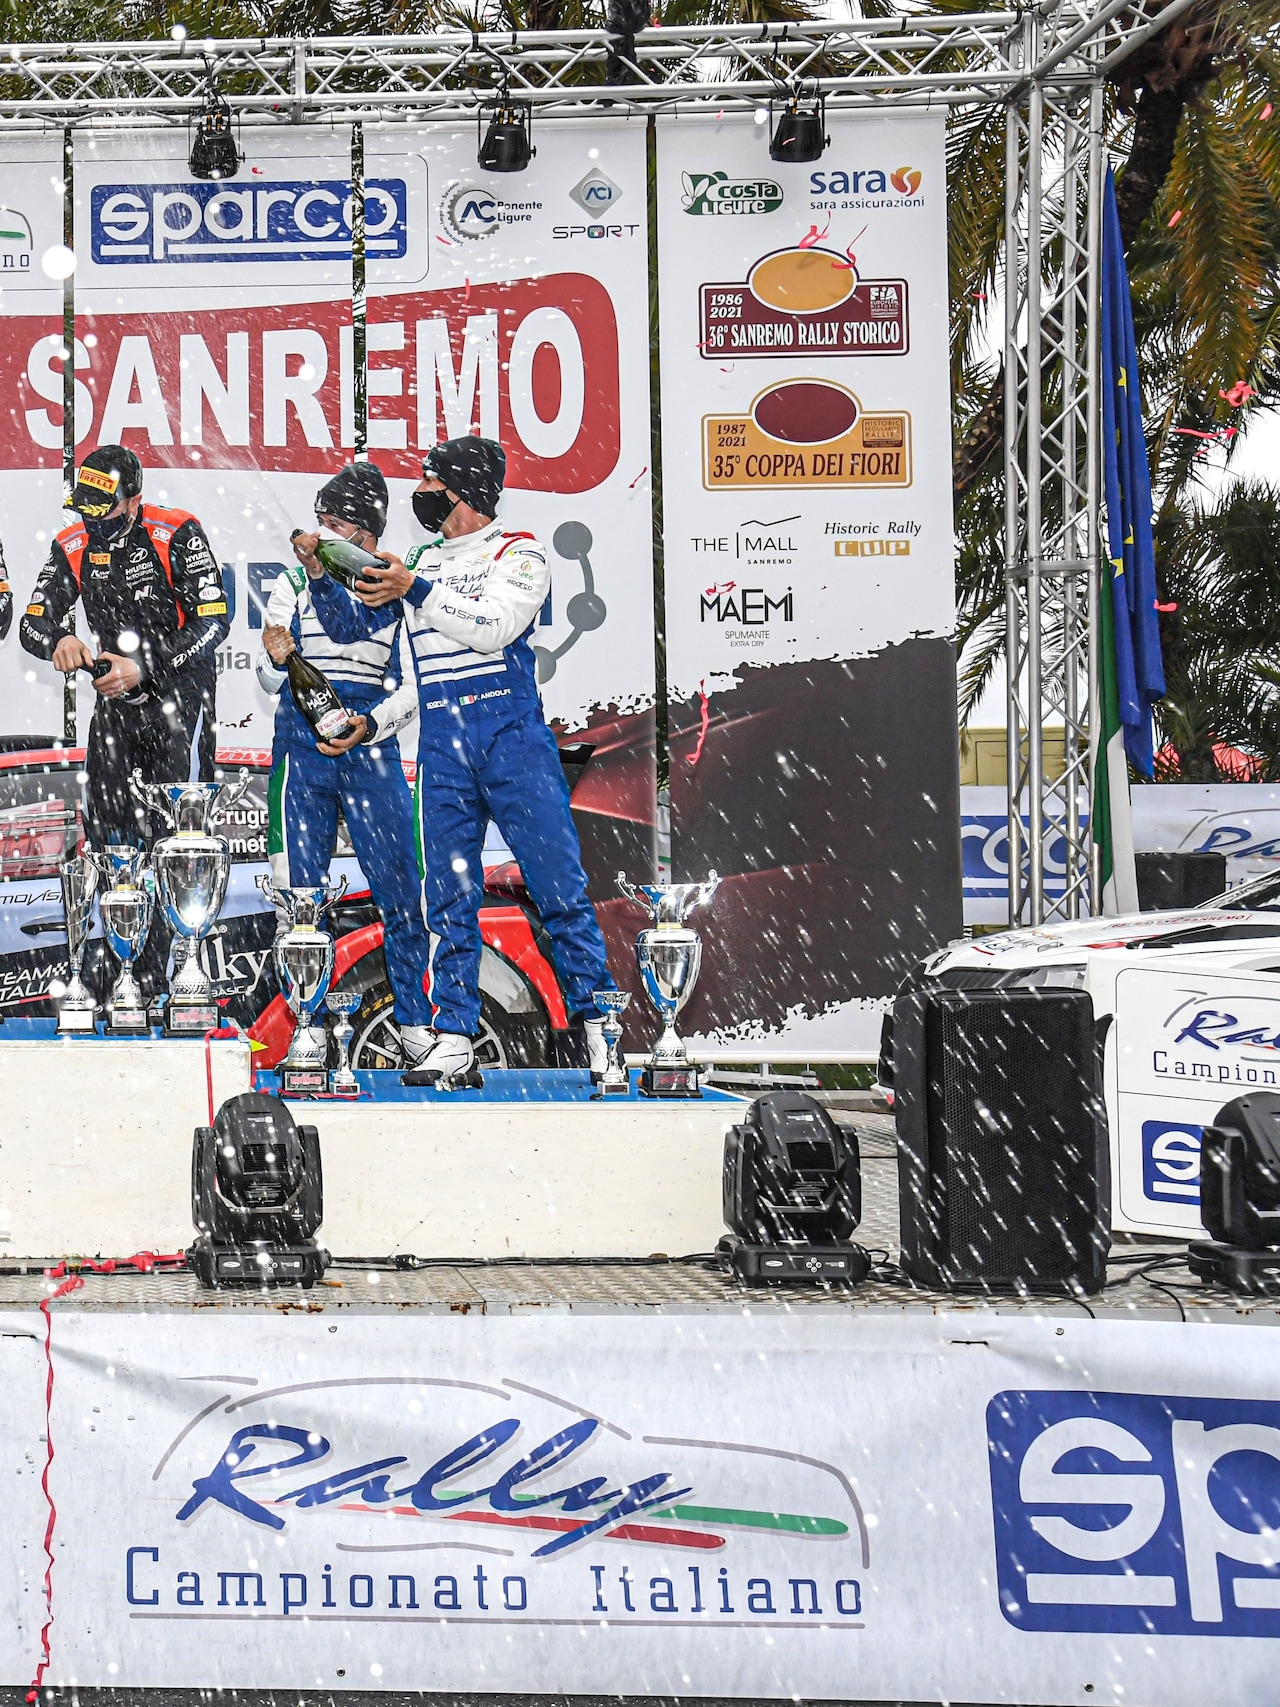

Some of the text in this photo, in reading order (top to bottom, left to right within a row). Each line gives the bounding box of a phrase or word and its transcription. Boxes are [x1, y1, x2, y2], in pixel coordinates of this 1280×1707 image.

[810, 170, 887, 194] sara
[585, 187, 612, 201] ACI
[497, 201, 543, 211] Ponente
[810, 196, 925, 210] sara assicurazioni
[459, 200, 497, 223] AC
[497, 213, 532, 224] Ligure
[100, 187, 398, 260] sparco
[552, 224, 640, 240] SPORT
[710, 294, 743, 306] 1986
[709, 307, 742, 318] 2021
[731, 323, 793, 347] SANREMO
[798, 321, 840, 346] RALLY
[843, 320, 900, 345] STORICO
[26, 308, 586, 452] SANREMO
[717, 424, 746, 435] 1987
[717, 437, 747, 447] 2021
[745, 454, 806, 477] COPPA
[812, 453, 843, 476] DEI
[849, 453, 901, 475] FIORI
[80, 470, 114, 490] PIRELLI
[153, 529, 170, 541] OMP
[824, 521, 922, 537] Historic Rally
[65, 540, 82, 551] OMP
[691, 537, 798, 551] THE MALL
[834, 539, 910, 557] CUP
[126, 561, 153, 575] HYUNDAI
[441, 604, 500, 626] ACI SPORT
[724, 630, 770, 639] SPUMANTE
[1153, 1050, 1277, 1084] Campion
[176, 1418, 692, 1558] Rally
[127, 1545, 863, 1618] Campionato Italiano
